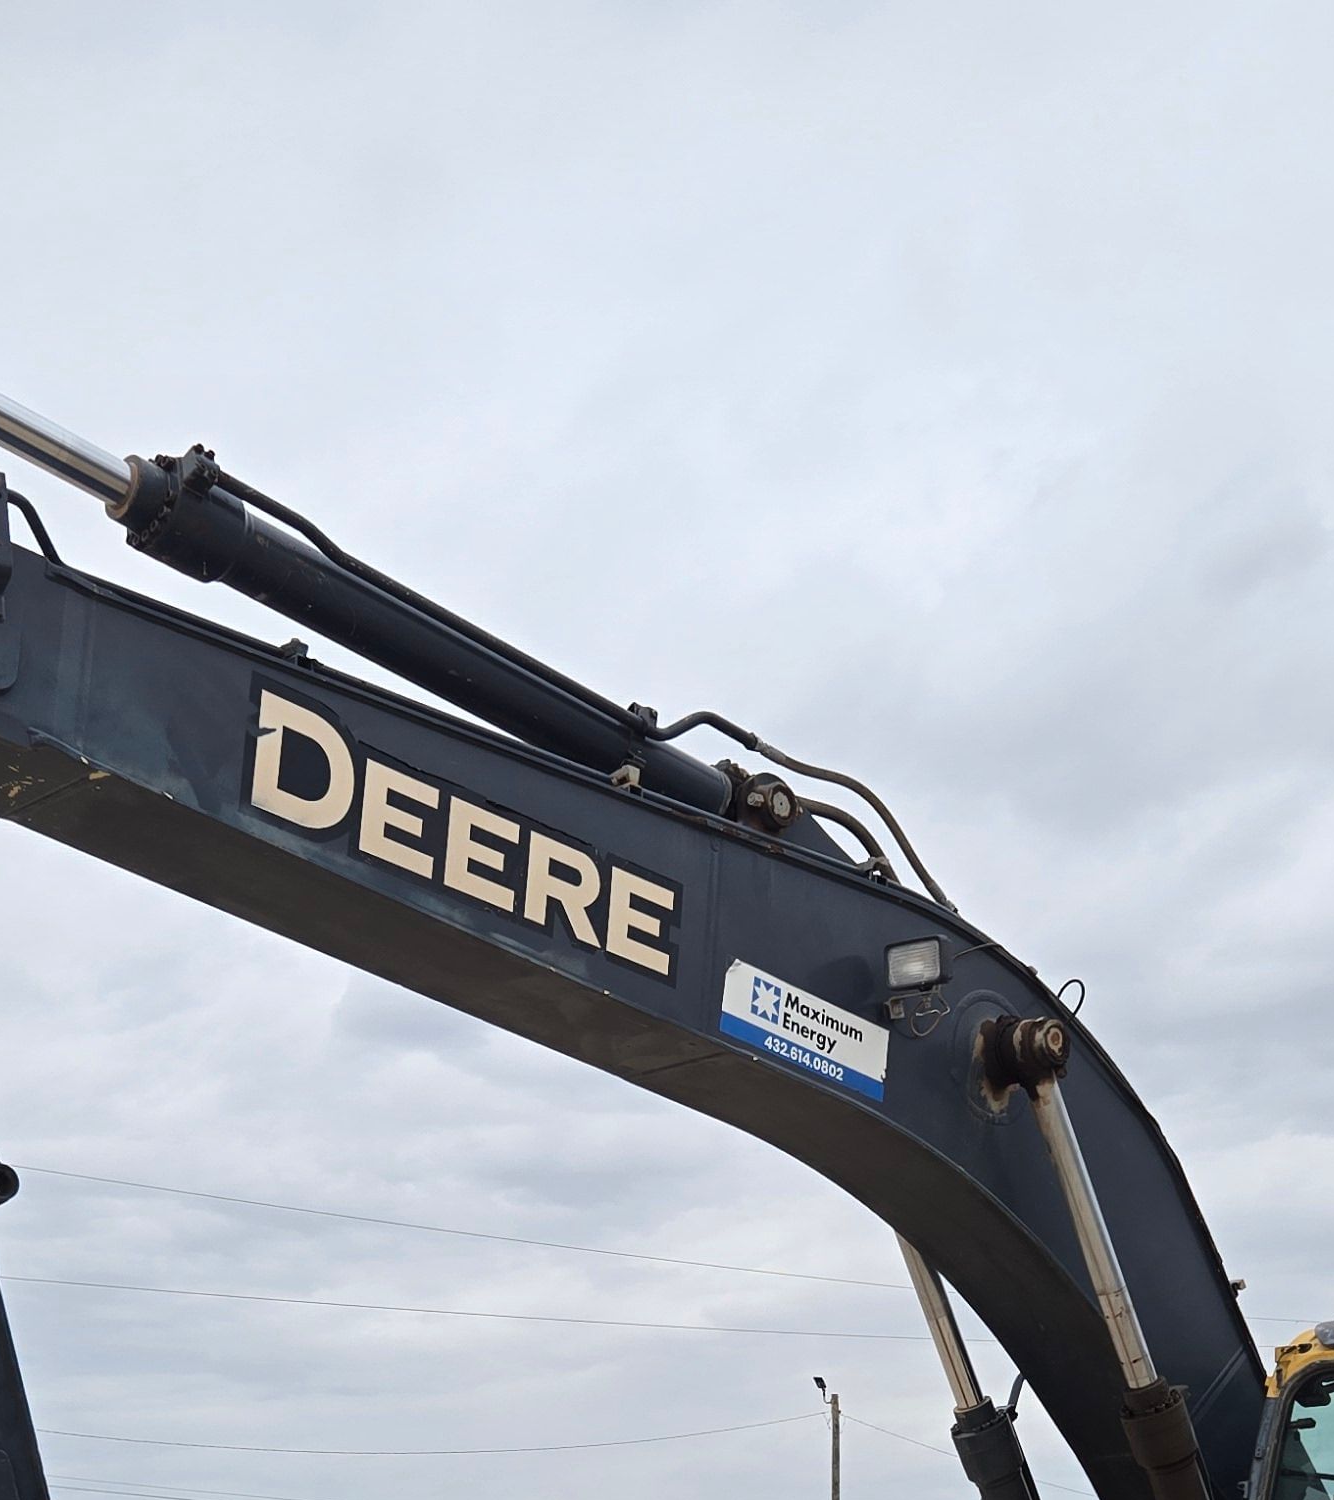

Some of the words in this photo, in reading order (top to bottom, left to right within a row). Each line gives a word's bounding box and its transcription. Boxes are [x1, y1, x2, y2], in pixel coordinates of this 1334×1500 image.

[251, 688, 675, 977] DEERE
[782, 1013, 837, 1053] Energy
[784, 992, 863, 1042] Maximum
[764, 1035, 844, 1081] 432.614.0802
